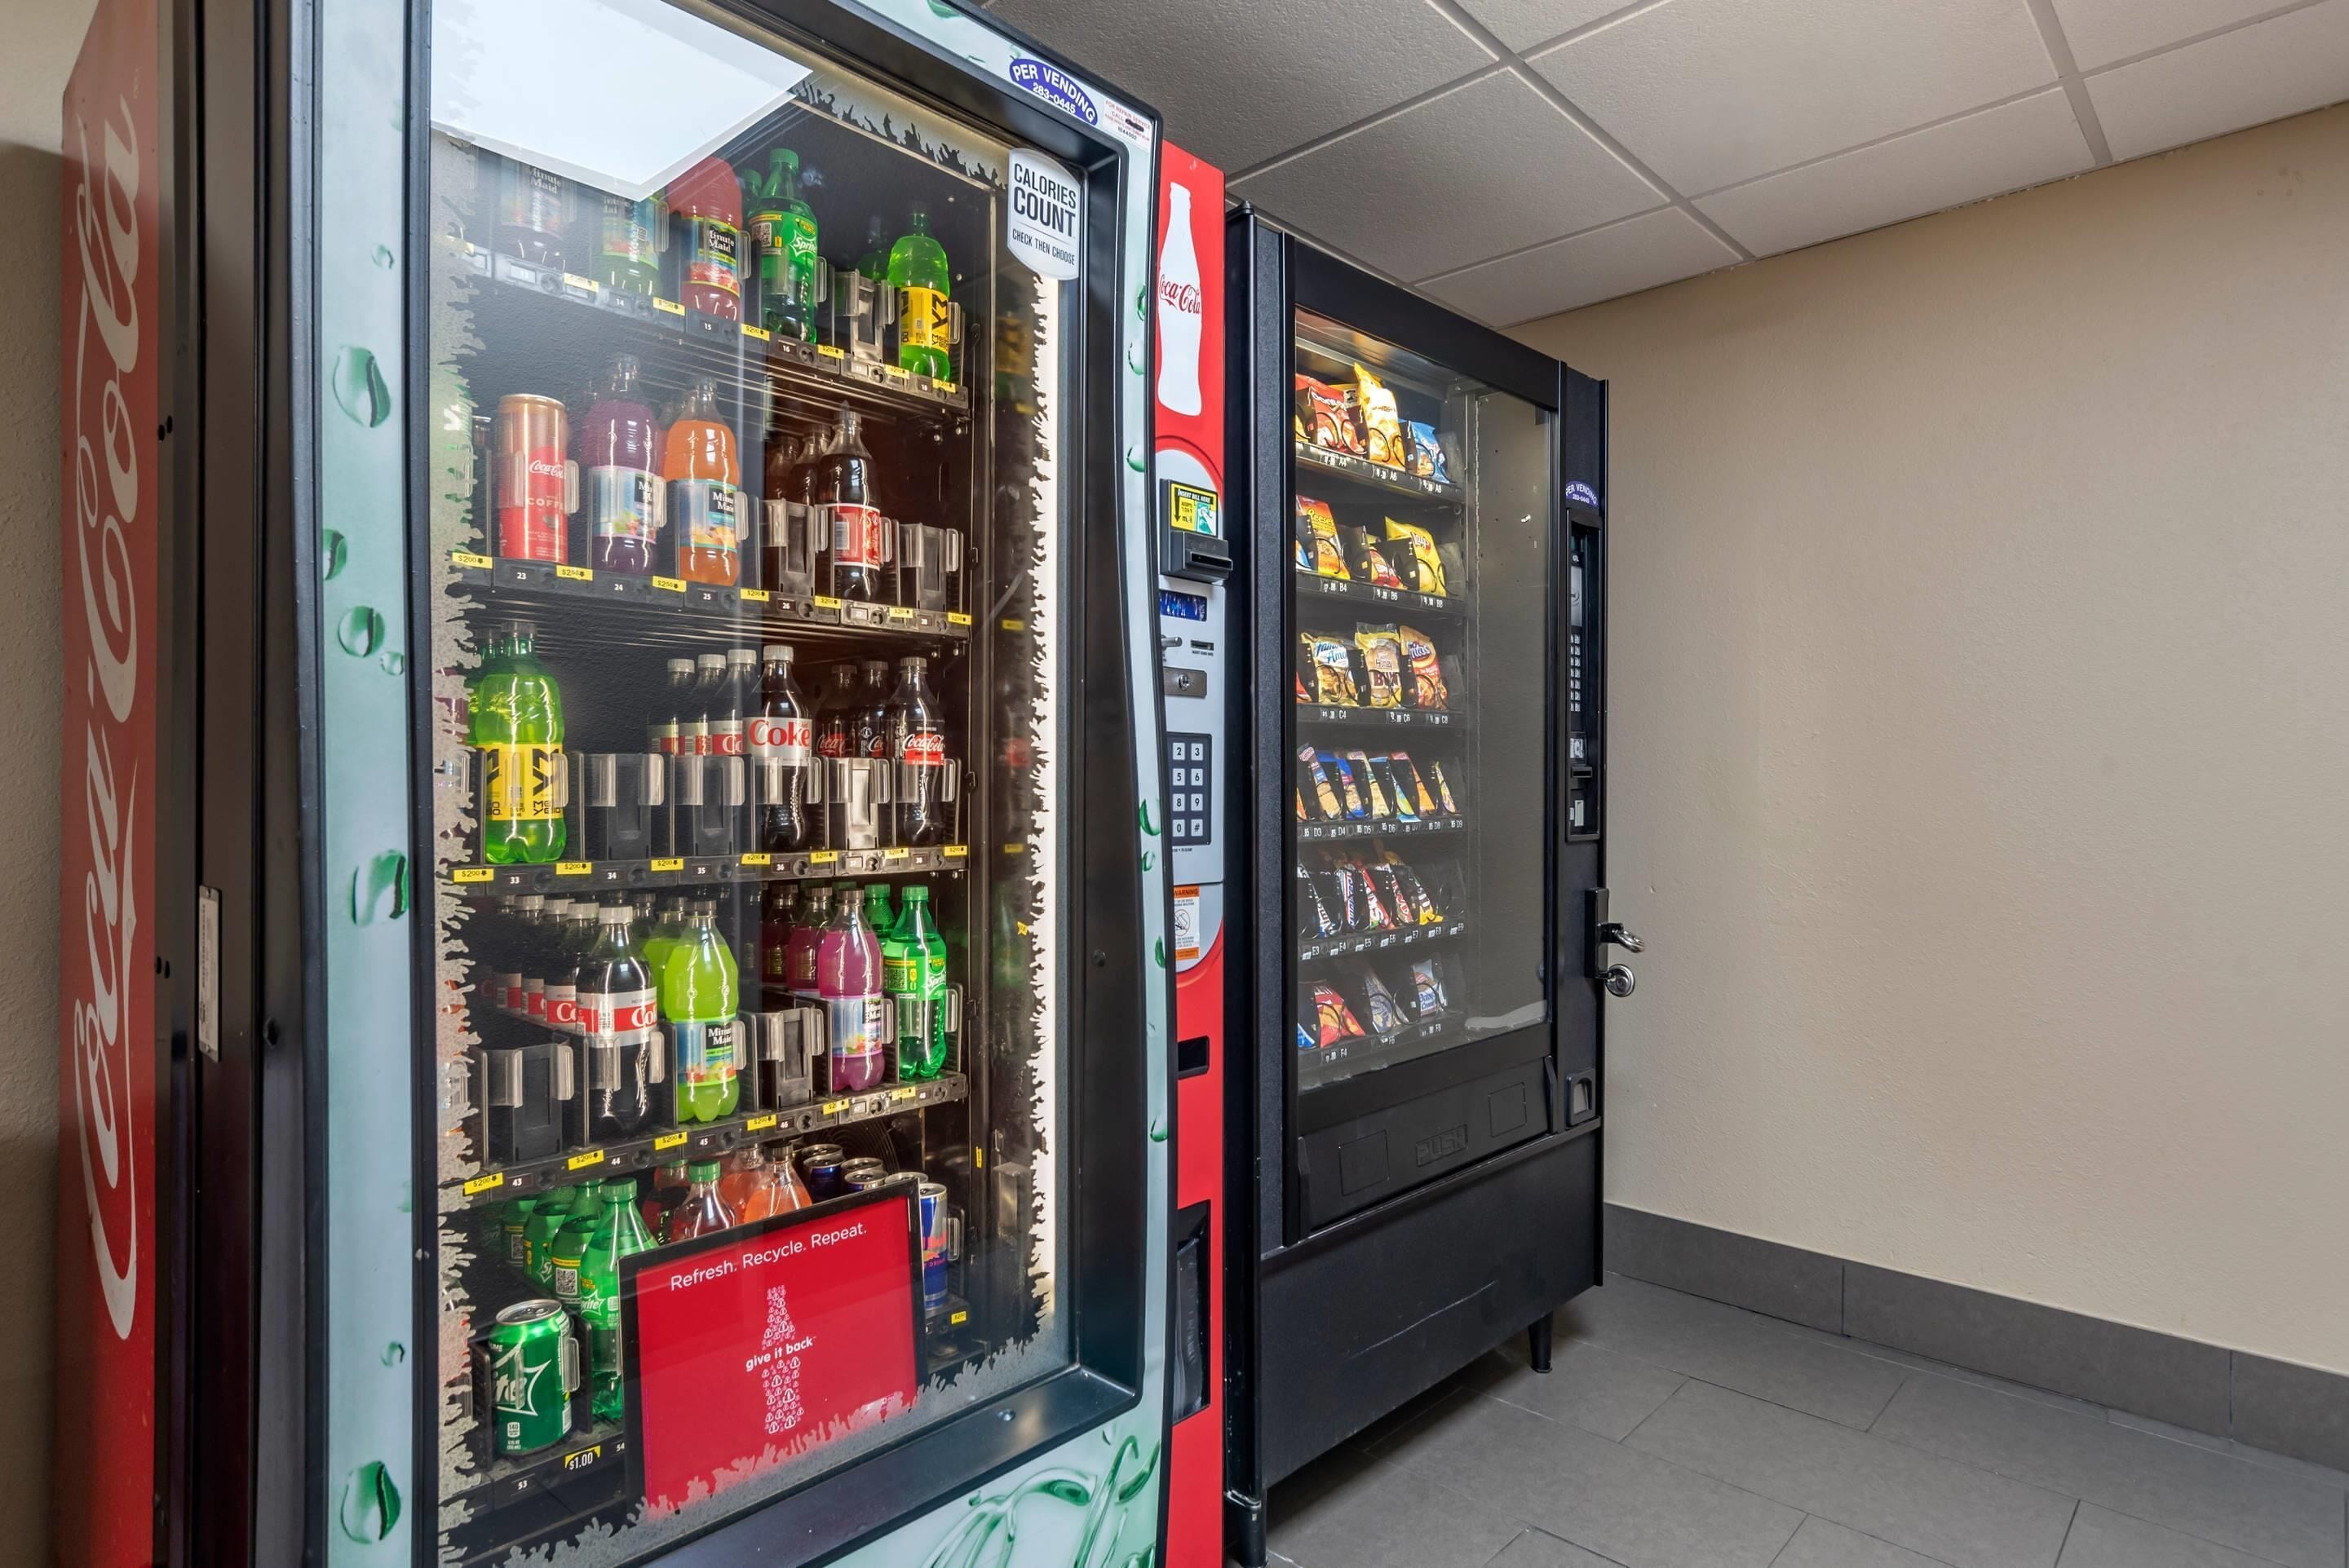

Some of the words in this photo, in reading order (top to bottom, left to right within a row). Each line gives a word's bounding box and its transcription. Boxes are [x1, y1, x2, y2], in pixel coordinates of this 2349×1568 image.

[1012, 64, 1038, 81] PER
[1042, 67, 1095, 122] VENDING
[1033, 82, 1076, 114] 283-0445
[1014, 163, 1077, 209] CALORIES
[1013, 187, 1075, 237] COUNT
[1012, 228, 1033, 247] CHECK
[1034, 236, 1050, 255] THEN
[1052, 244, 1075, 266] CHOOSE
[704, 322, 712, 330] 15
[516, 572, 526, 580] 23
[74, 92, 139, 1340] Coca-Cola
[748, 719, 810, 747] Coke
[1176, 746, 1182, 756] 2
[1194, 747, 1200, 757] 3
[1176, 772, 1182, 782] 5
[1194, 772, 1200, 782] 6
[1176, 797, 1182, 807] 8
[1194, 797, 1200, 807] 9
[1176, 823, 1182, 833] 0
[1194, 823, 1200, 833] #
[509, 876, 520, 885] 33
[607, 872, 617, 880] 34
[781, 1121, 789, 1129] 46
[699, 1137, 709, 1146] 45
[611, 1157, 621, 1165] 44
[473, 1177, 491, 1187] $200
[512, 1177, 522, 1186] 43
[670, 1260, 737, 1291] Refresh.
[742, 1240, 807, 1269] Recycle.
[811, 1222, 867, 1248] Repeat.
[745, 1350, 771, 1371] give
[774, 1345, 783, 1358] it
[786, 1336, 813, 1355] back
[616, 1442, 625, 1451] 54
[569, 1452, 593, 1470] $1.00
[517, 1480, 528, 1490] 53
